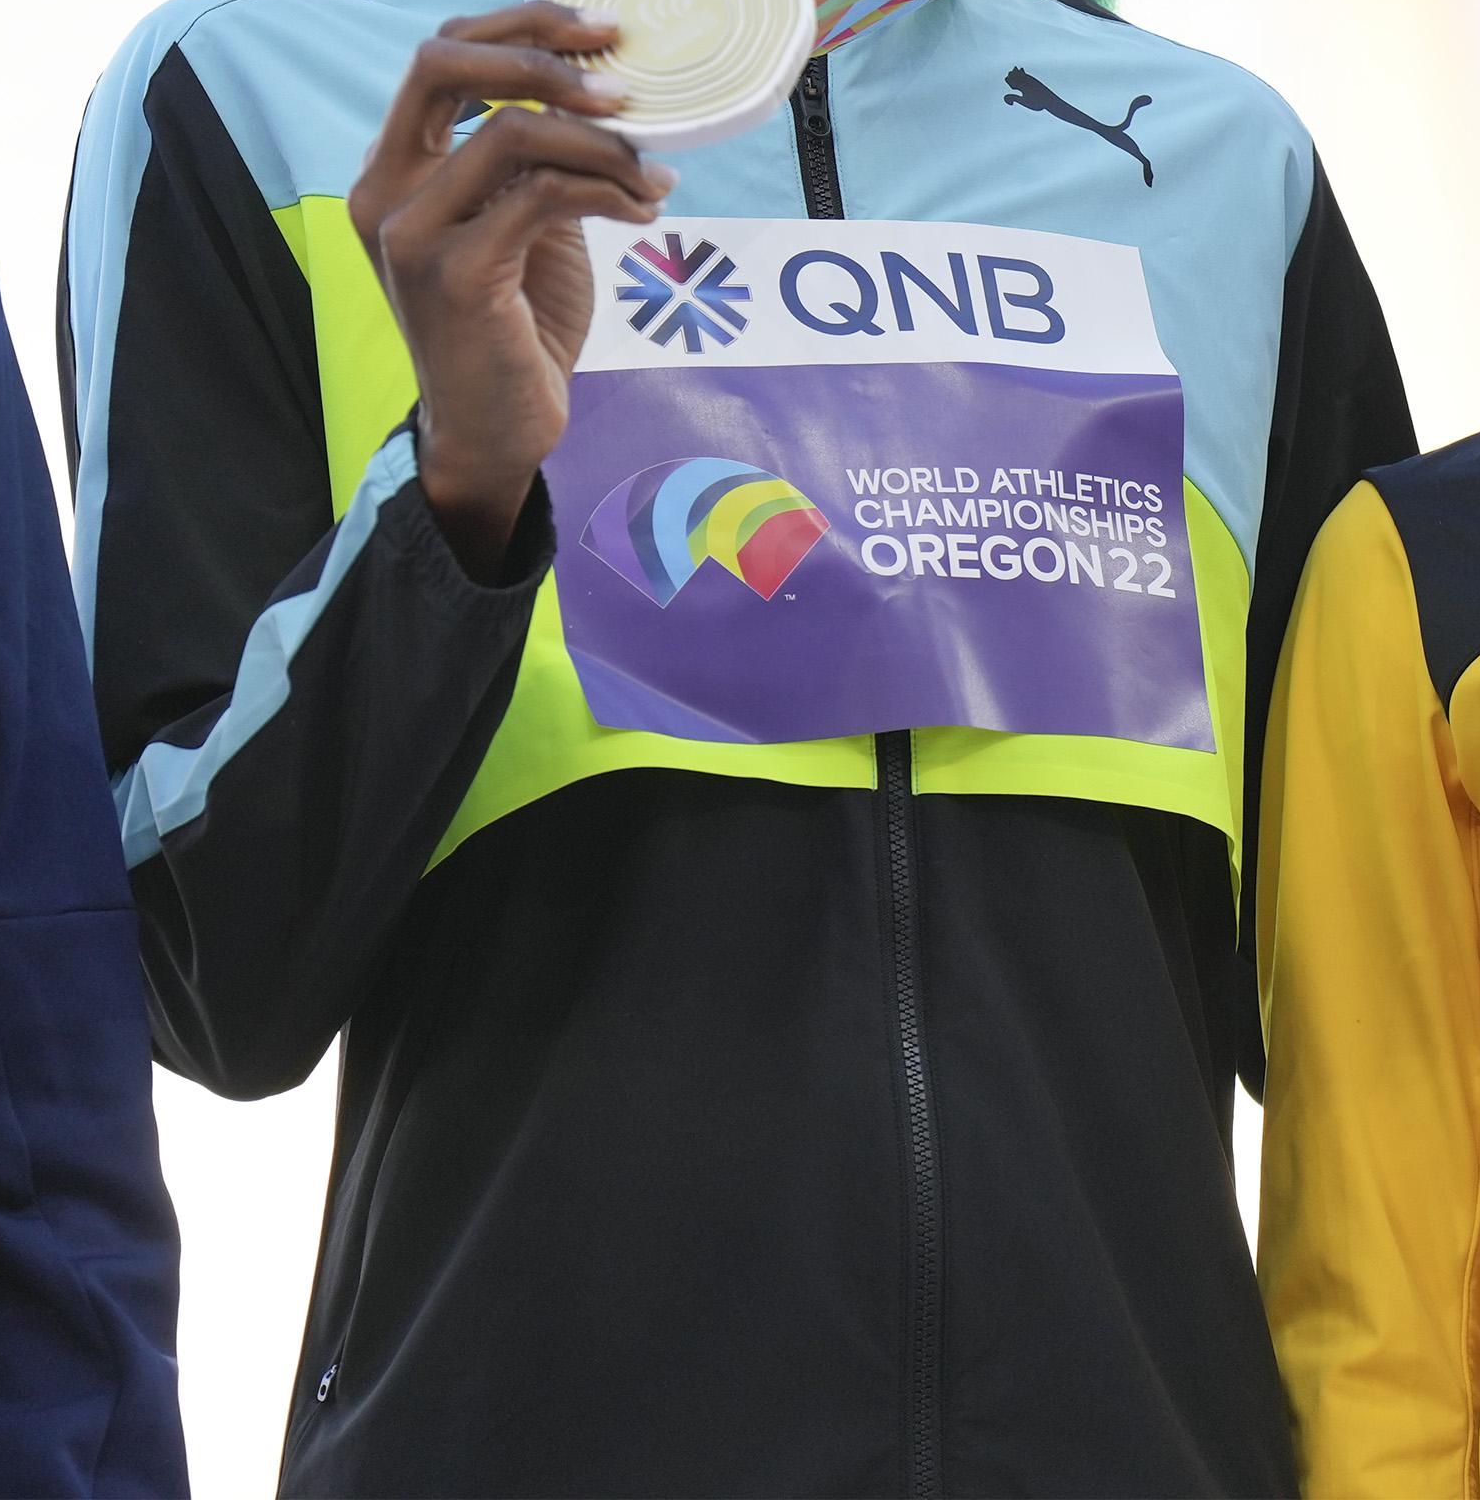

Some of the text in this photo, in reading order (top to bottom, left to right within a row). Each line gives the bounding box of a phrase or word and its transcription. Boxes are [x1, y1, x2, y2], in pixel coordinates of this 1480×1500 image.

[779, 249, 1066, 344] QNB
[846, 468, 1163, 513] WORLD ATHLETICS
[854, 498, 1168, 548] CHAMPIONSHIPS
